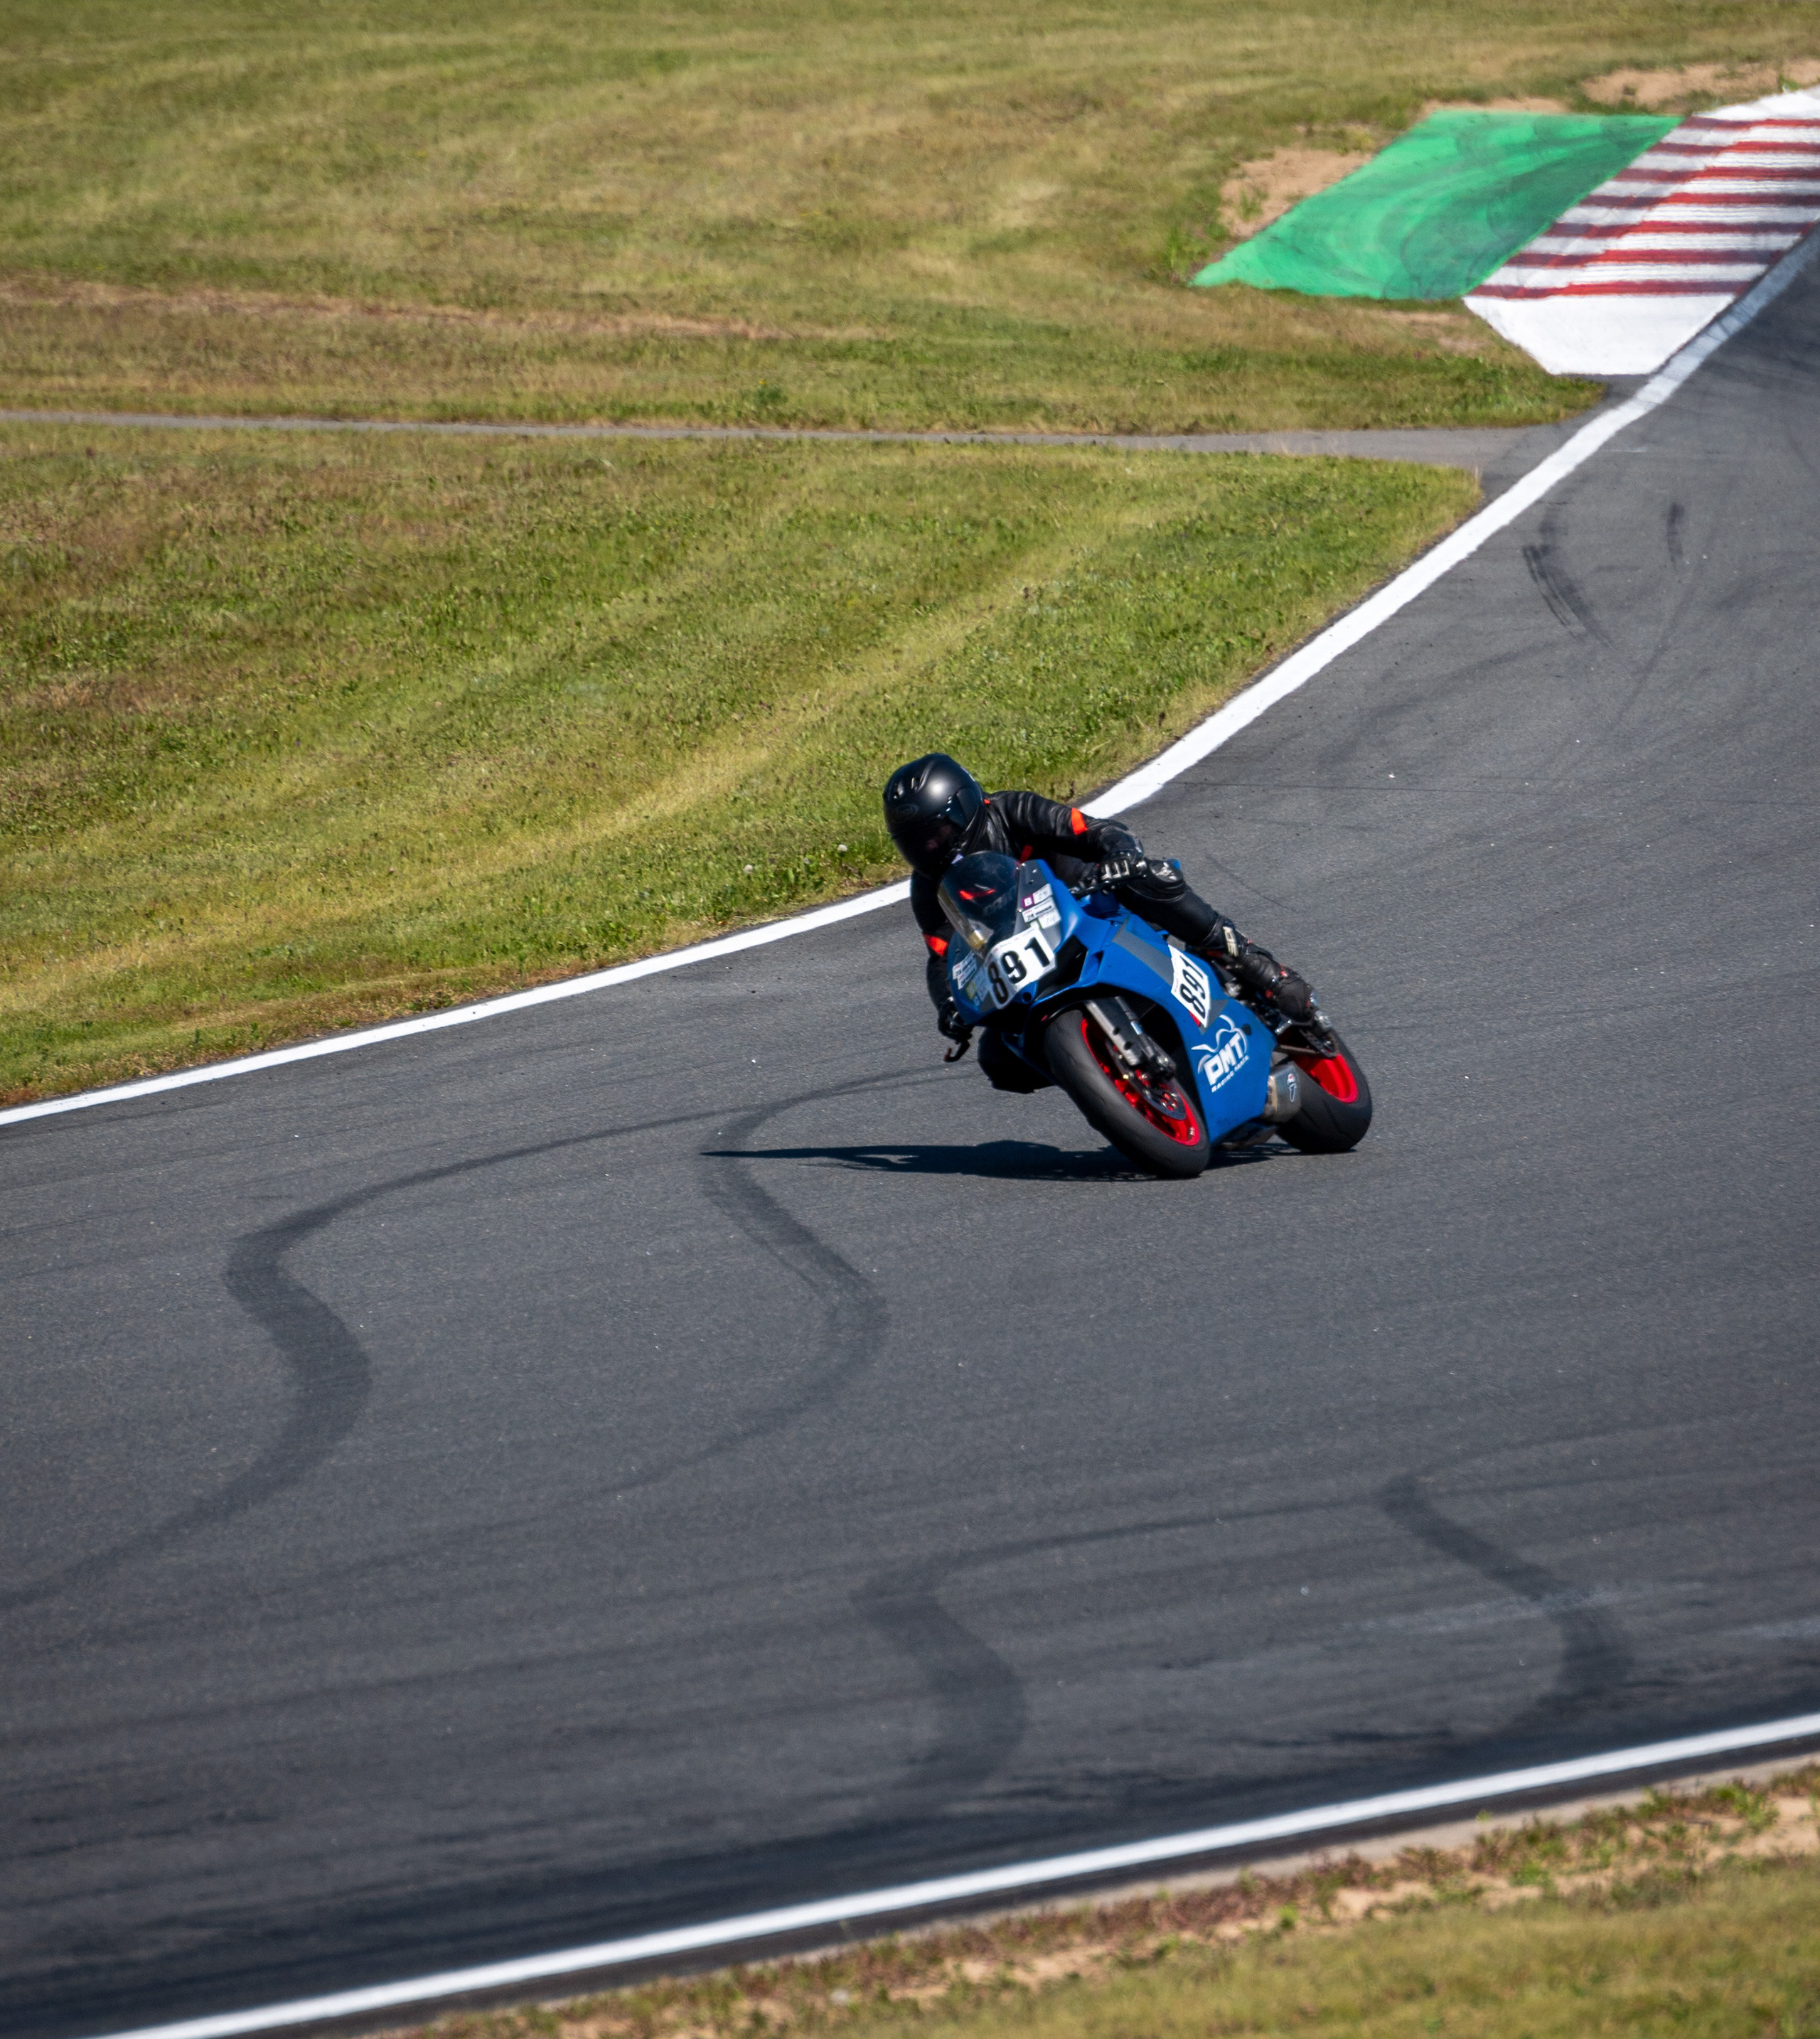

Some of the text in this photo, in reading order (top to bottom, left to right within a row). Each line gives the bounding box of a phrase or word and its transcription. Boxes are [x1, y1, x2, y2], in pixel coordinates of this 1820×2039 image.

[987, 936, 1051, 1005] 891
[1179, 955, 1206, 1020] 891
[1204, 1032, 1244, 1086] PMT
